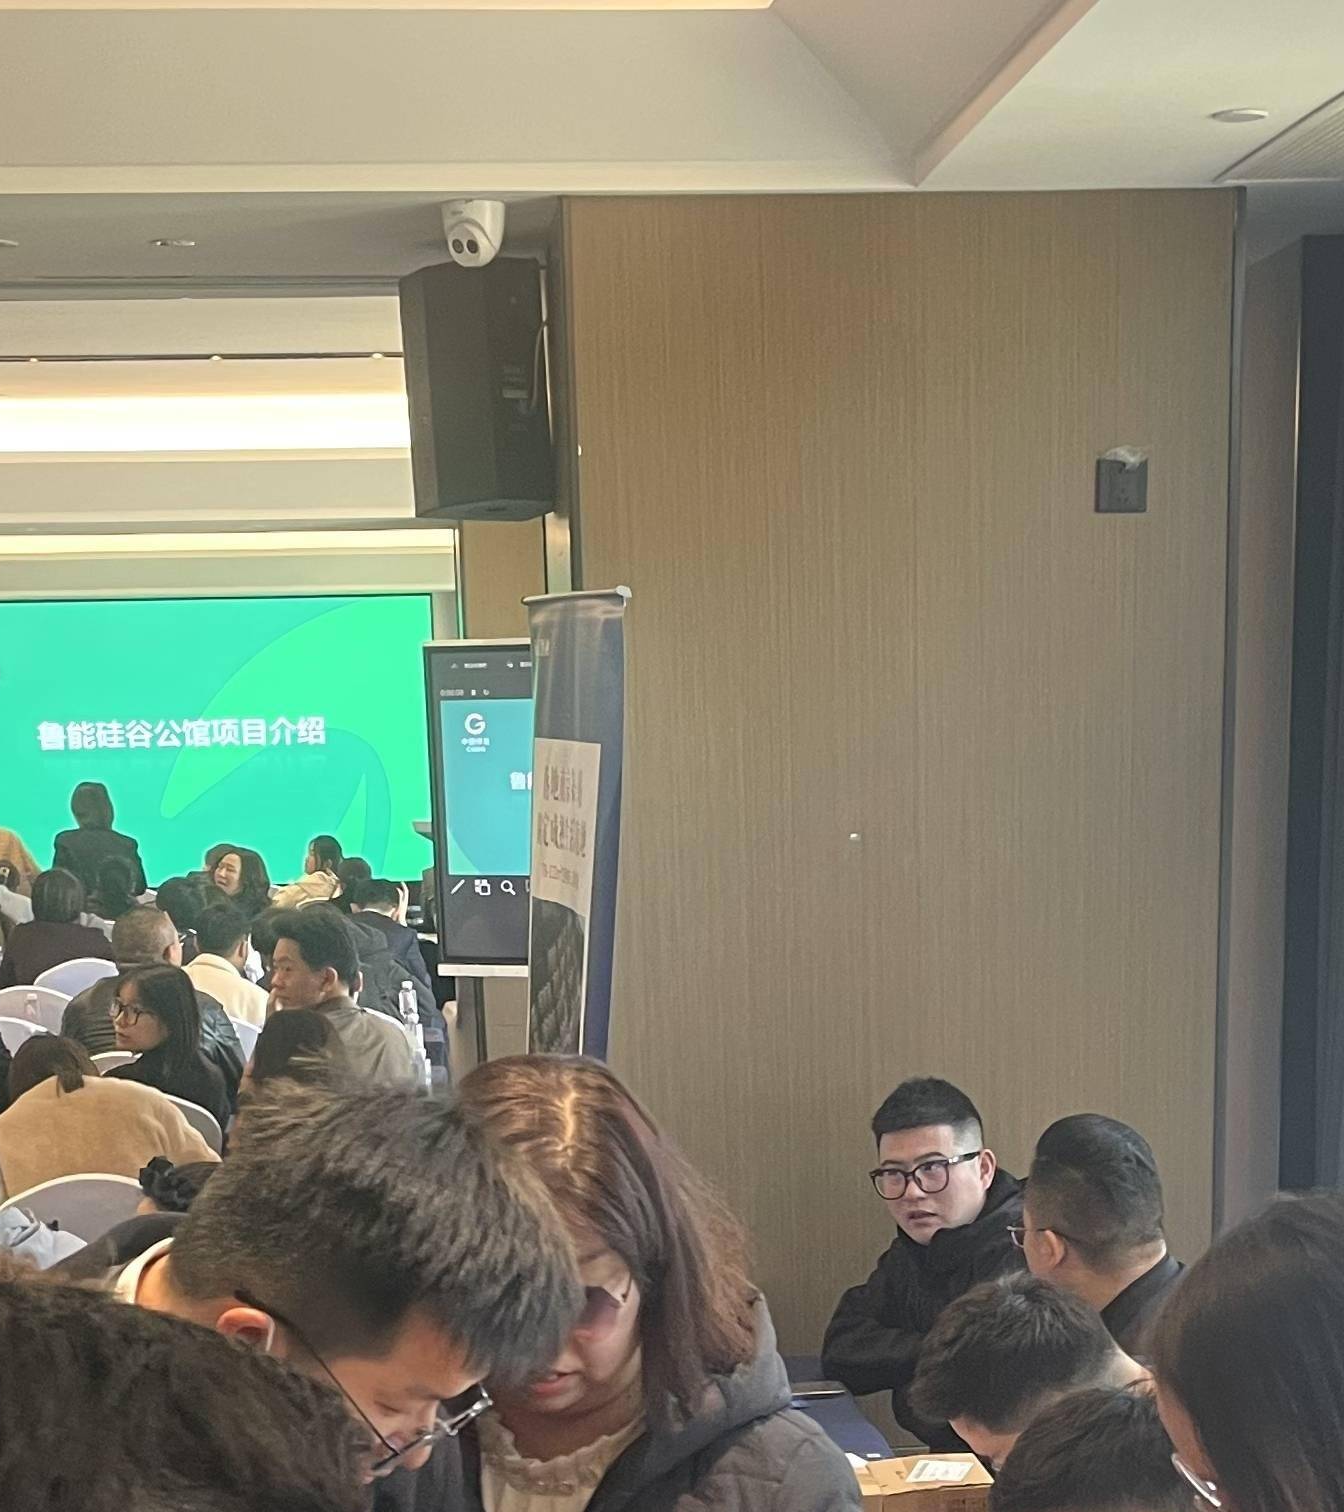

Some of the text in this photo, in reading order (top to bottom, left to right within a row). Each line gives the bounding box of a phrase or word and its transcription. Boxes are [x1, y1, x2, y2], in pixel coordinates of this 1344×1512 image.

[37, 716, 327, 751] 鲁能硅谷公馆项目介绍
